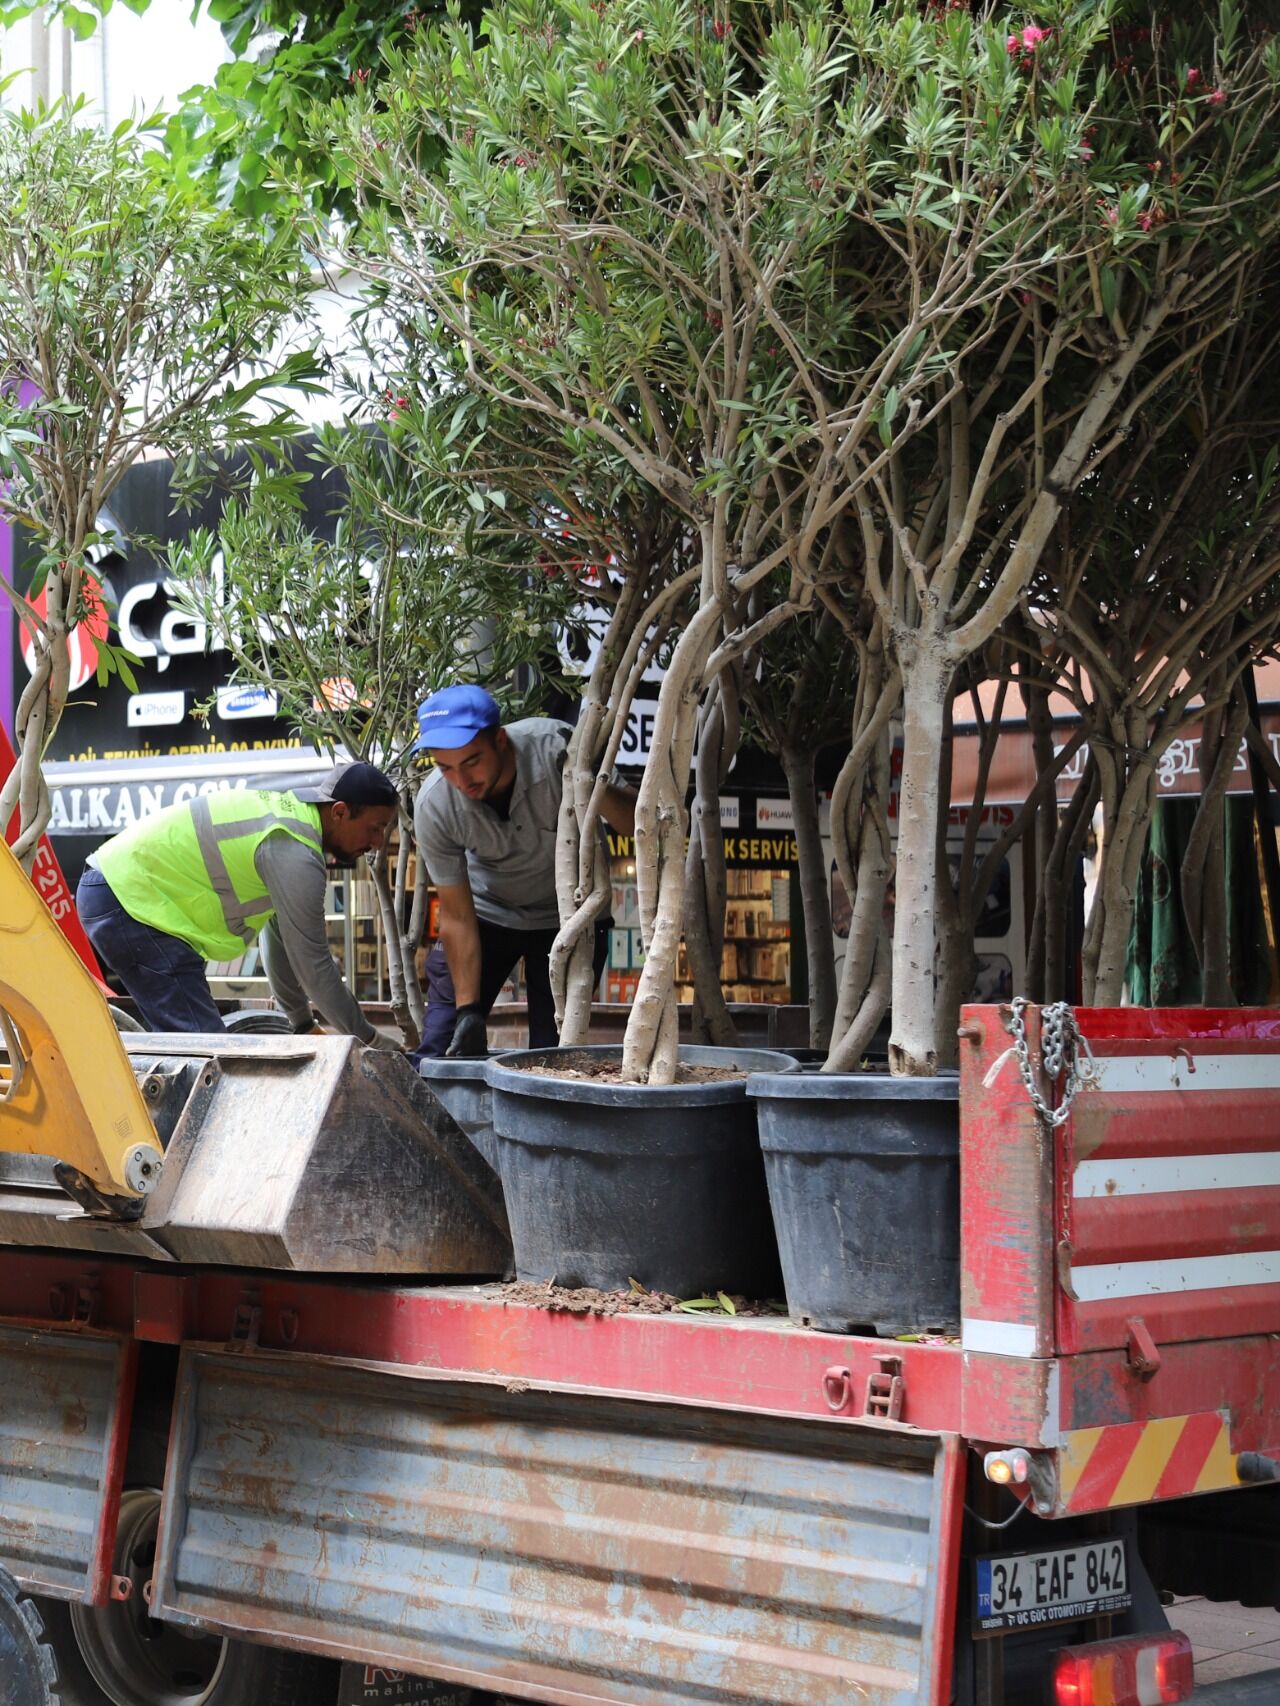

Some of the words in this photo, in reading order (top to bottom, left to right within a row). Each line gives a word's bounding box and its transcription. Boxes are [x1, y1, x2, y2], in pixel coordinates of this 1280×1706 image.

[144, 703, 178, 716] iPhone
[739, 834, 798, 860] SERVİS
[992, 1562, 1023, 1610] 34
[1035, 1552, 1076, 1604] EAF
[1086, 1545, 1124, 1595] 842
[979, 1593, 991, 1606] TR
[364, 1680, 434, 1697] makina
